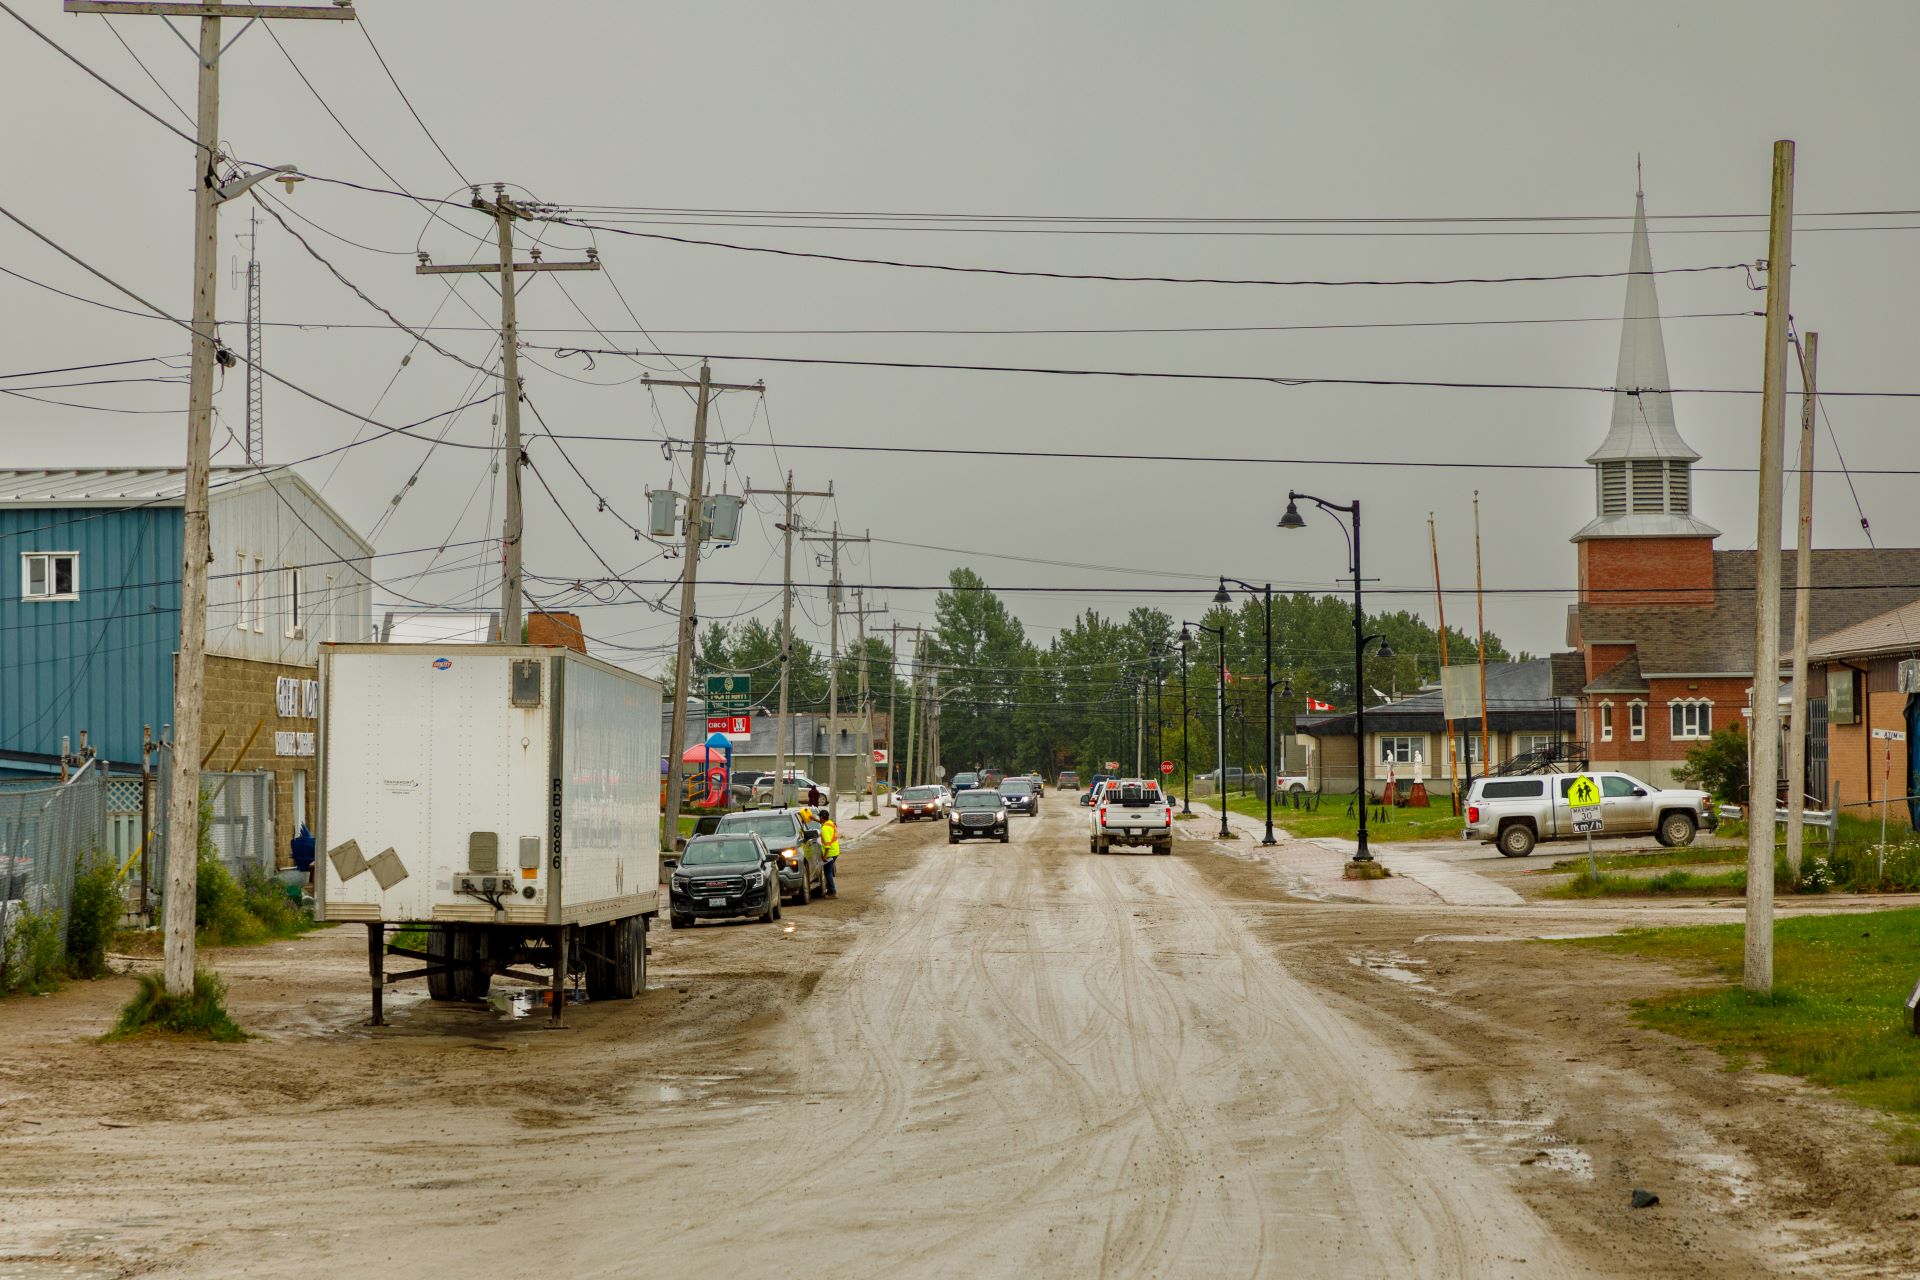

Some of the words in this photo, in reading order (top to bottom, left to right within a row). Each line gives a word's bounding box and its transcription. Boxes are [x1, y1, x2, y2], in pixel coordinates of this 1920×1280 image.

[276, 676, 299, 718] GREAT
[552, 778, 562, 870] RB9886
[1573, 820, 1602, 832] km/h
[1581, 811, 1592, 820] 30
